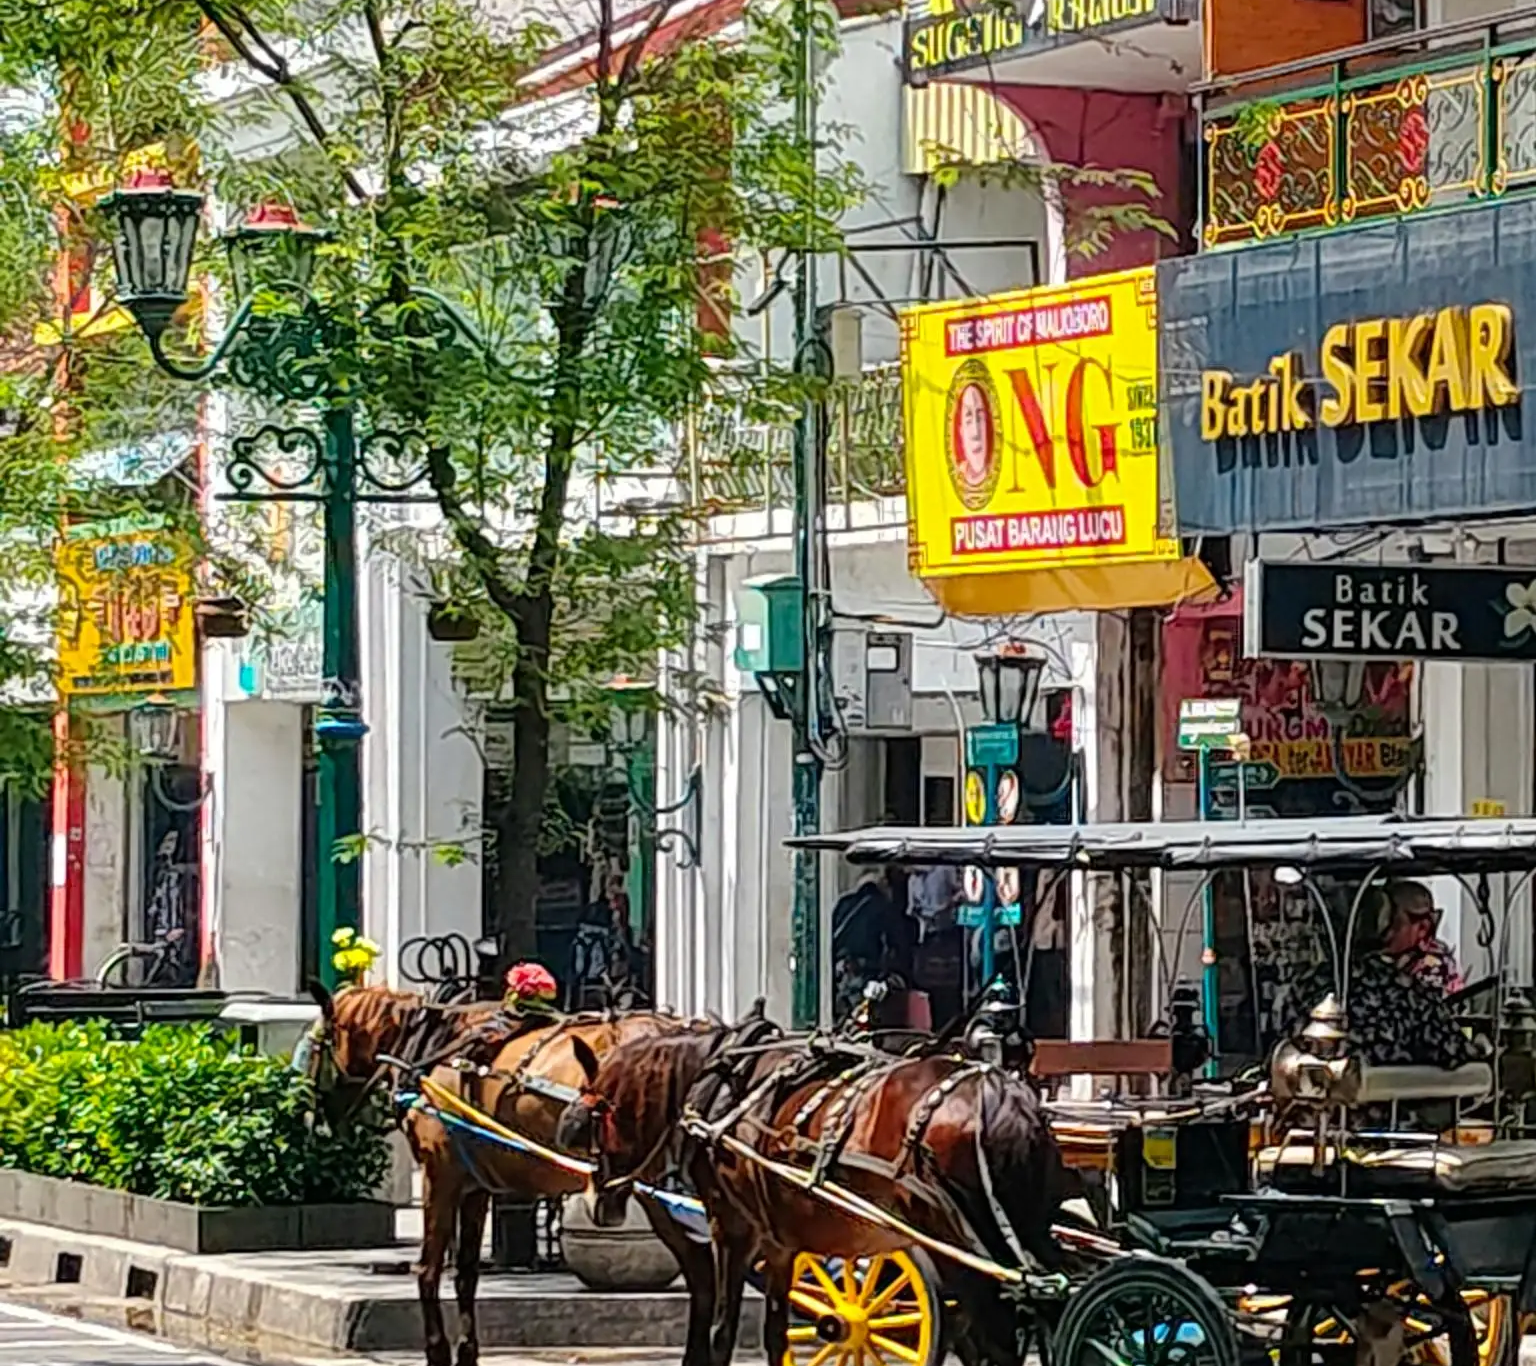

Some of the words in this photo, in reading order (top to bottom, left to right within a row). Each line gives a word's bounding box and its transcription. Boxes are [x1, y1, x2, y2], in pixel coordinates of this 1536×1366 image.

[948, 322, 974, 352] THE
[975, 313, 1015, 349] SPIRIT
[1016, 311, 1034, 341] OF
[1199, 351, 1312, 442] Batik
[1319, 301, 1520, 427] SEKAR
[954, 519, 1006, 552] PUSAT
[1007, 513, 1078, 547] BARANG
[1078, 510, 1124, 542] LUCU
[1334, 572, 1430, 605] Batik
[1301, 607, 1463, 651] SEKAR
